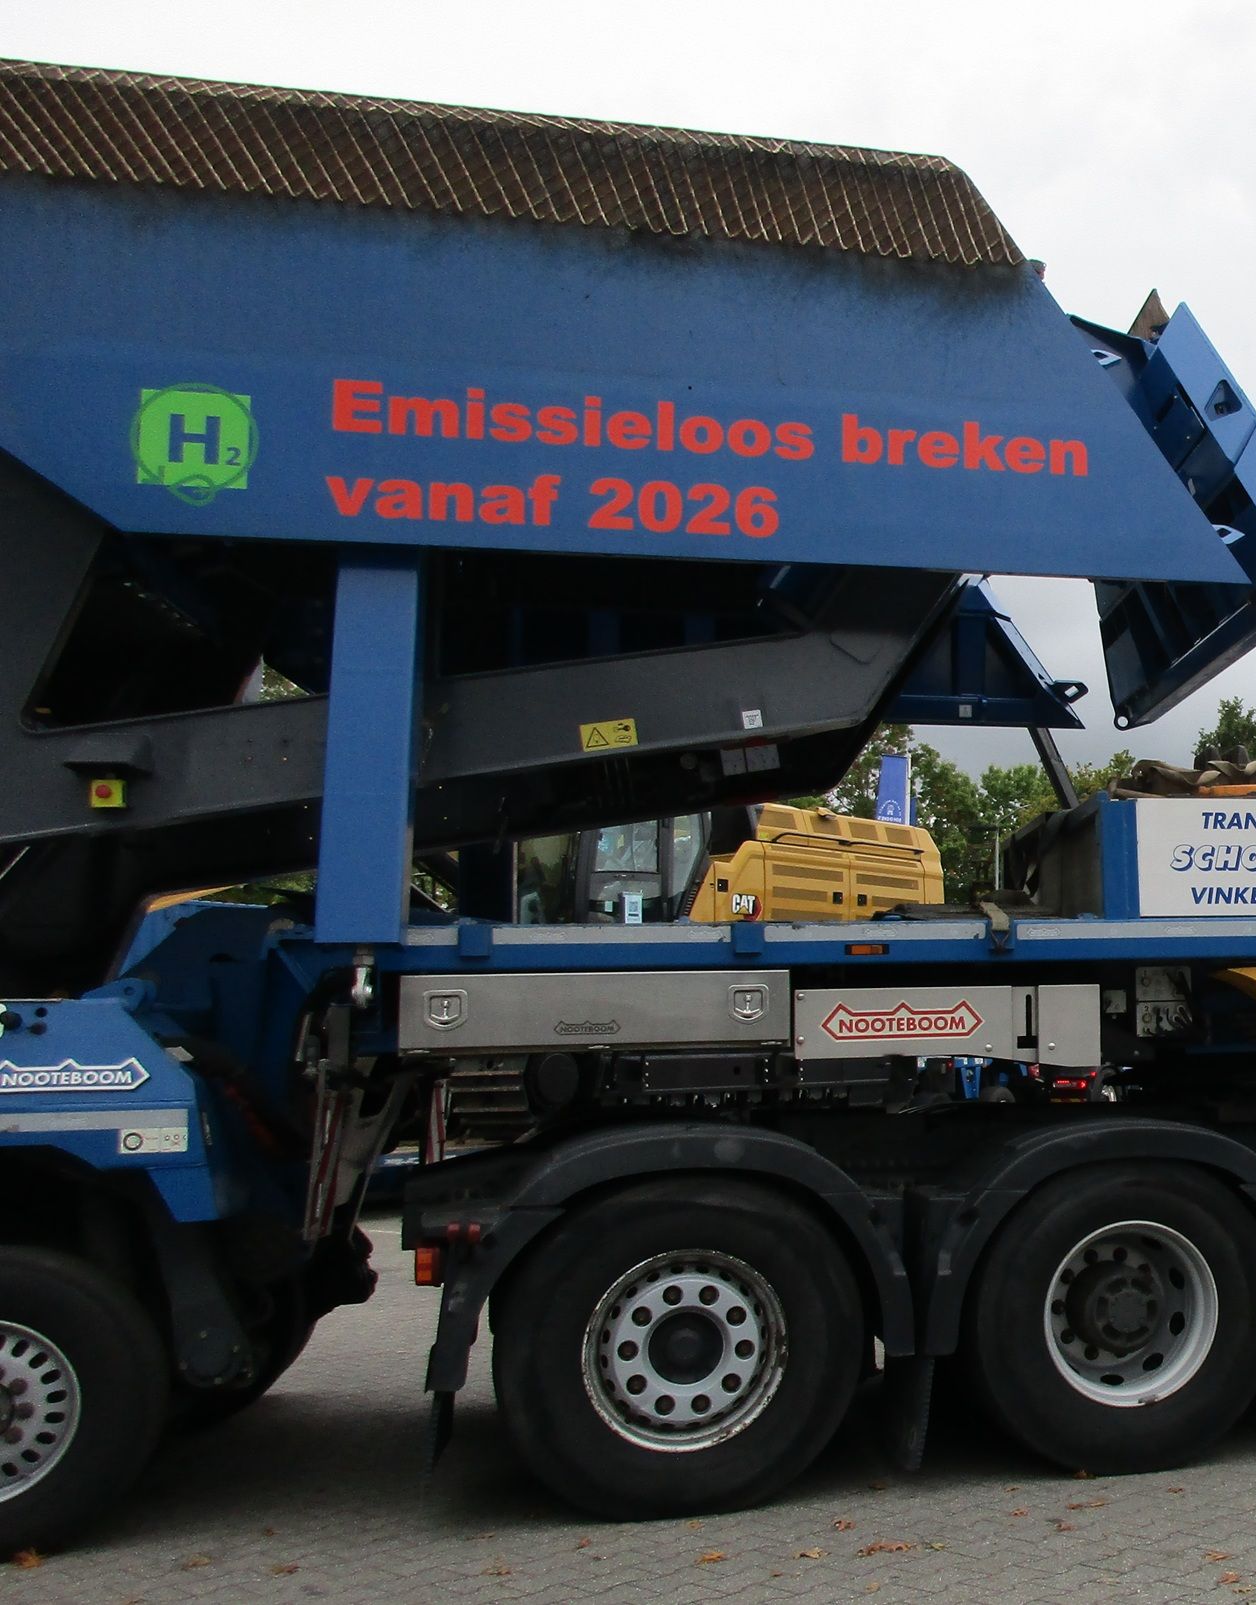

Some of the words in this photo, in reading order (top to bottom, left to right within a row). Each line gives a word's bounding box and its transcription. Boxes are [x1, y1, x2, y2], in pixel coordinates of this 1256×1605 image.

[332, 379, 815, 461] Emissieloos
[841, 413, 1089, 477] breken
[326, 474, 561, 526] vanaf
[588, 477, 779, 538] 2026
[732, 893, 756, 915] CAT
[838, 1016, 966, 1034] NOOTEBOOM
[1, 1071, 133, 1086] NOOTEBOOM
